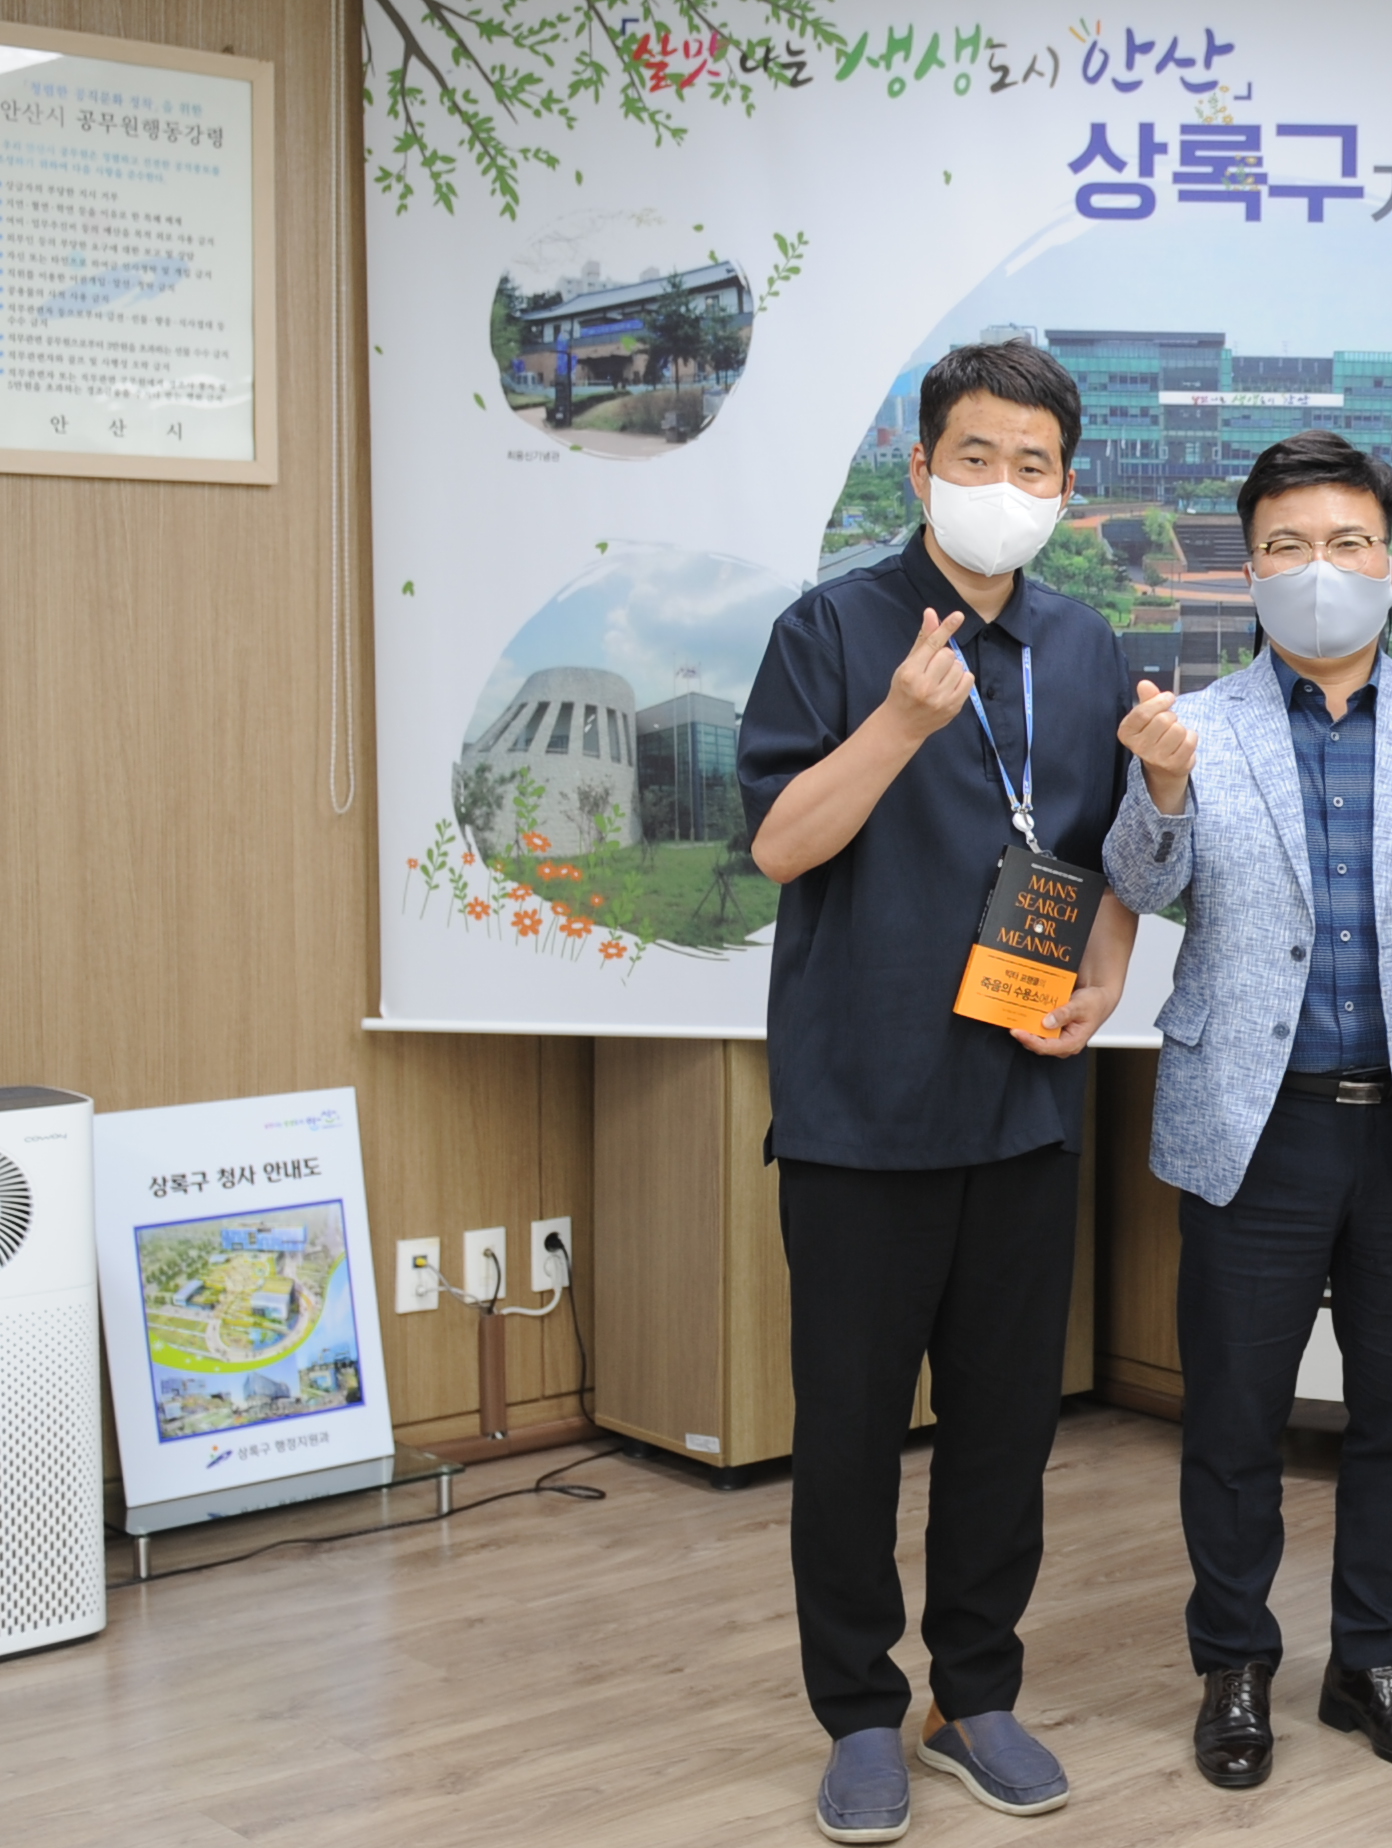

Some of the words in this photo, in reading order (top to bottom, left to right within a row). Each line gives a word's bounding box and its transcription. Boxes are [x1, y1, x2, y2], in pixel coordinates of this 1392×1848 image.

[0, 99, 65, 128] 안산시
[76, 108, 224, 149] 공무원행동강령
[50, 415, 69, 435] 안
[109, 418, 127, 438] 산
[166, 421, 184, 441] 시
[1015, 892, 1079, 923] SEARCH
[997, 927, 1071, 962] MEANING
[981, 976, 1013, 996] 죽음의
[1013, 986, 1058, 1008] 수용소에서
[149, 1170, 209, 1198] 상록구
[217, 1164, 256, 1190] 청사
[263, 1156, 322, 1183] 안내도
[238, 1442, 271, 1461] 상록구
[275, 1431, 329, 1453] 행정지원과
